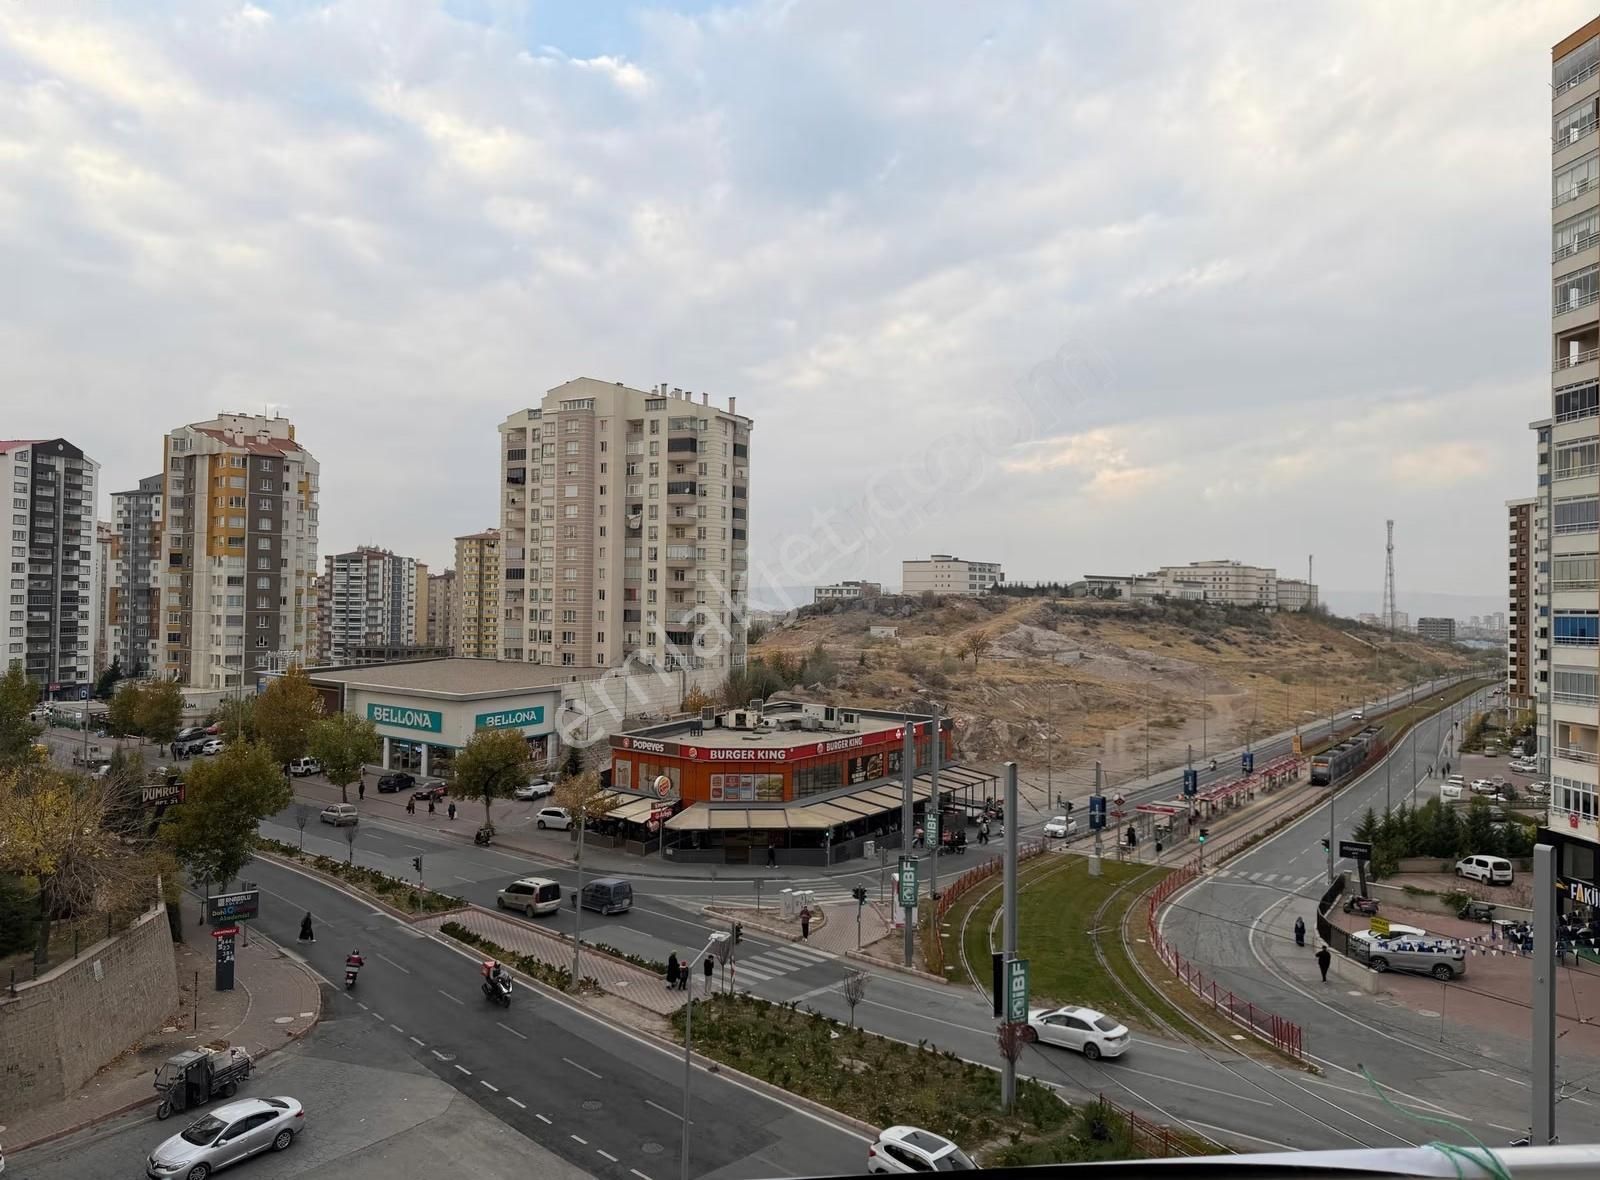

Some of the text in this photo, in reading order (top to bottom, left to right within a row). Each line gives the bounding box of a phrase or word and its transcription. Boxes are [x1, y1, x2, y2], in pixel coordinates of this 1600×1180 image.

[373, 706, 432, 728] BELLONA
[486, 711, 537, 727] BELLONA
[826, 736, 863, 752] BURGER KING
[710, 749, 786, 760] BURGER KING
[142, 785, 180, 803] DUMRUL
